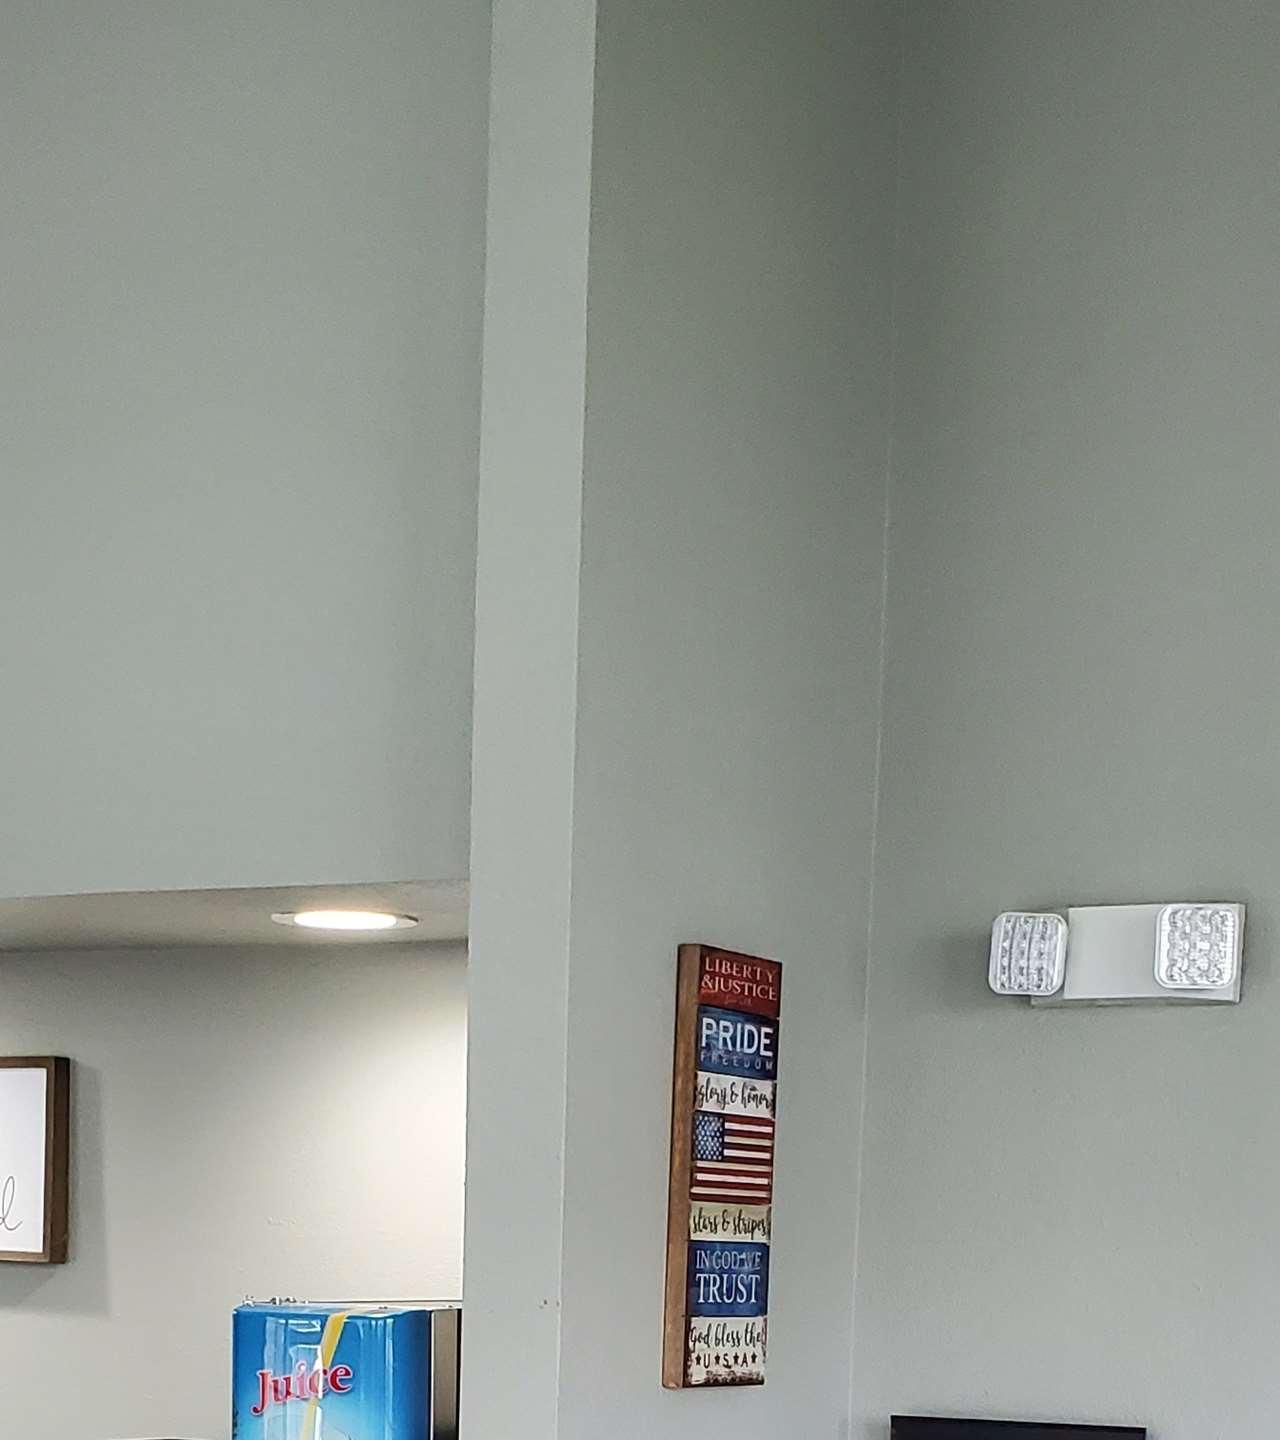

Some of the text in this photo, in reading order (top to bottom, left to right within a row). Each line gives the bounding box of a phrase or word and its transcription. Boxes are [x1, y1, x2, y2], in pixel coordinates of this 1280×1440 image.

[705, 957, 777, 983] LIBERTY
[700, 1017, 773, 1056] PRIDE
[700, 1050, 773, 1071] FREEDOM
[697, 1077, 770, 1110] glory & honor
[693, 1207, 767, 1240] stars & stripes
[696, 1250, 711, 1269] IN
[713, 1251, 738, 1269] GOD
[695, 1273, 760, 1303] TRUST
[690, 1322, 761, 1352] God bless the
[250, 1358, 355, 1415] Juice
